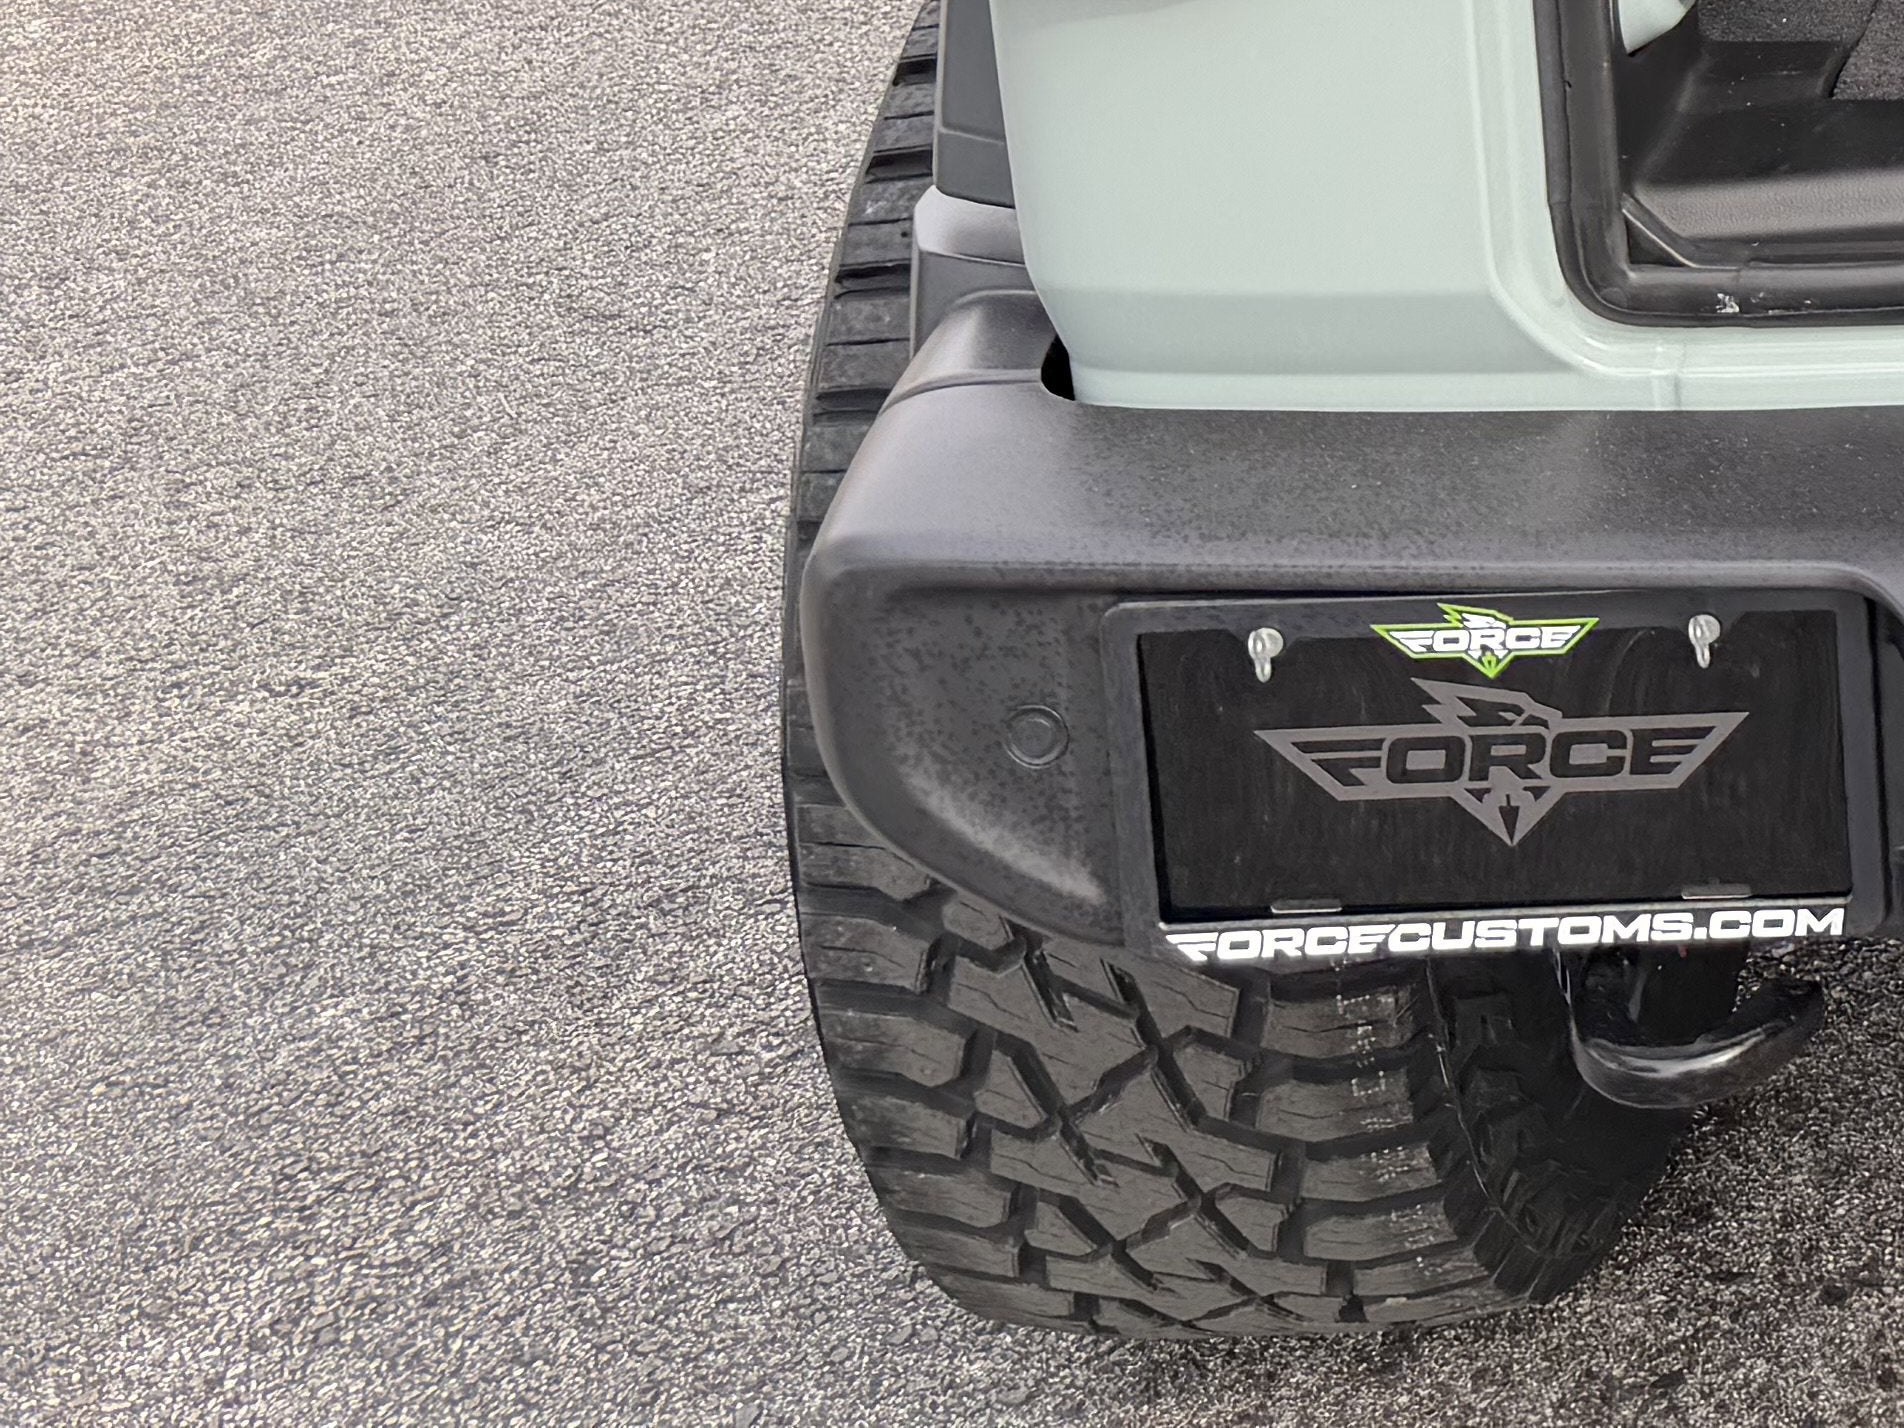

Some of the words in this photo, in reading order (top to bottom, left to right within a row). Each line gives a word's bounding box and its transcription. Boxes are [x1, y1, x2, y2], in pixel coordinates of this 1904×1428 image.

[1388, 625, 1582, 653] FORCE
[1290, 726, 1719, 788] FORCE
[1166, 908, 1844, 963] FORCECUSTOMS.COM
